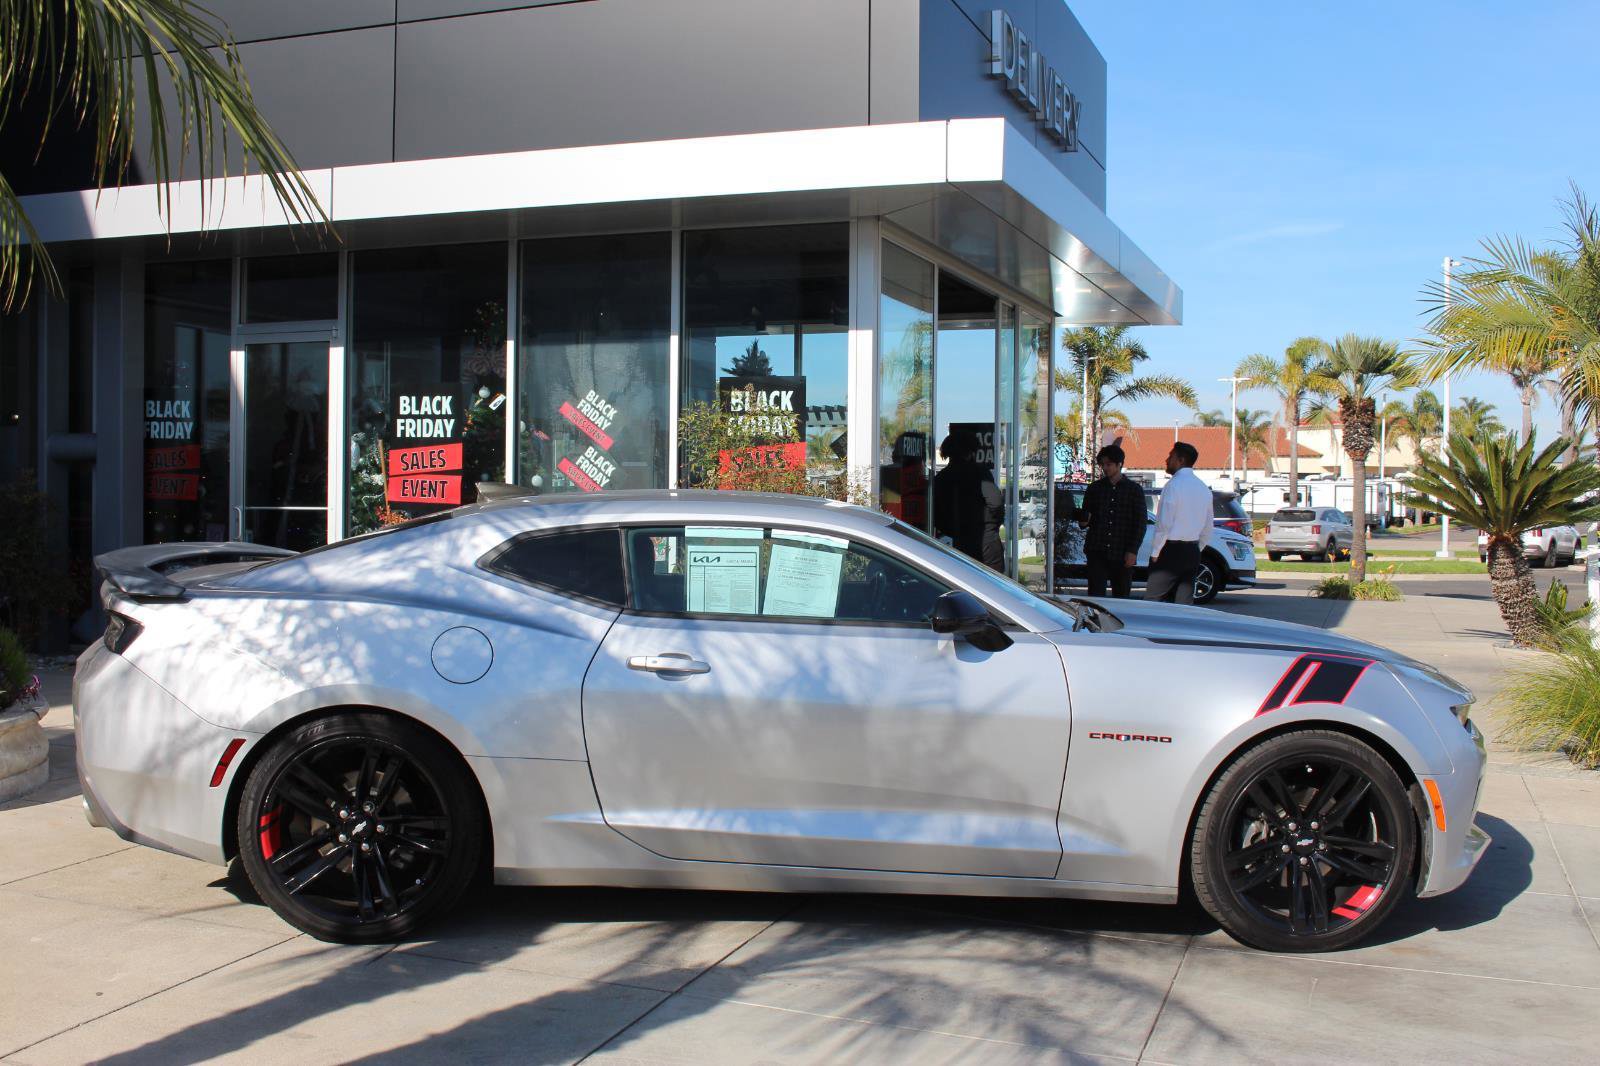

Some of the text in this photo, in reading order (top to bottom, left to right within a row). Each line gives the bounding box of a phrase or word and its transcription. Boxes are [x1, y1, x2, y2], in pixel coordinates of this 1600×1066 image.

[991, 10, 1081, 151] DELIVERY
[146, 400, 191, 418] BLACK
[399, 395, 453, 415] BLACK
[588, 390, 618, 420] BLACK
[731, 390, 794, 411] BLACK
[577, 399, 611, 430] FRIDAY
[396, 418, 456, 438] FRIDAY
[400, 449, 447, 472] SALES
[575, 455, 610, 487] FRIDAY
[584, 446, 616, 477] BLACK
[401, 479, 448, 499] EVENT
[1089, 732, 1172, 743] CAMARO
